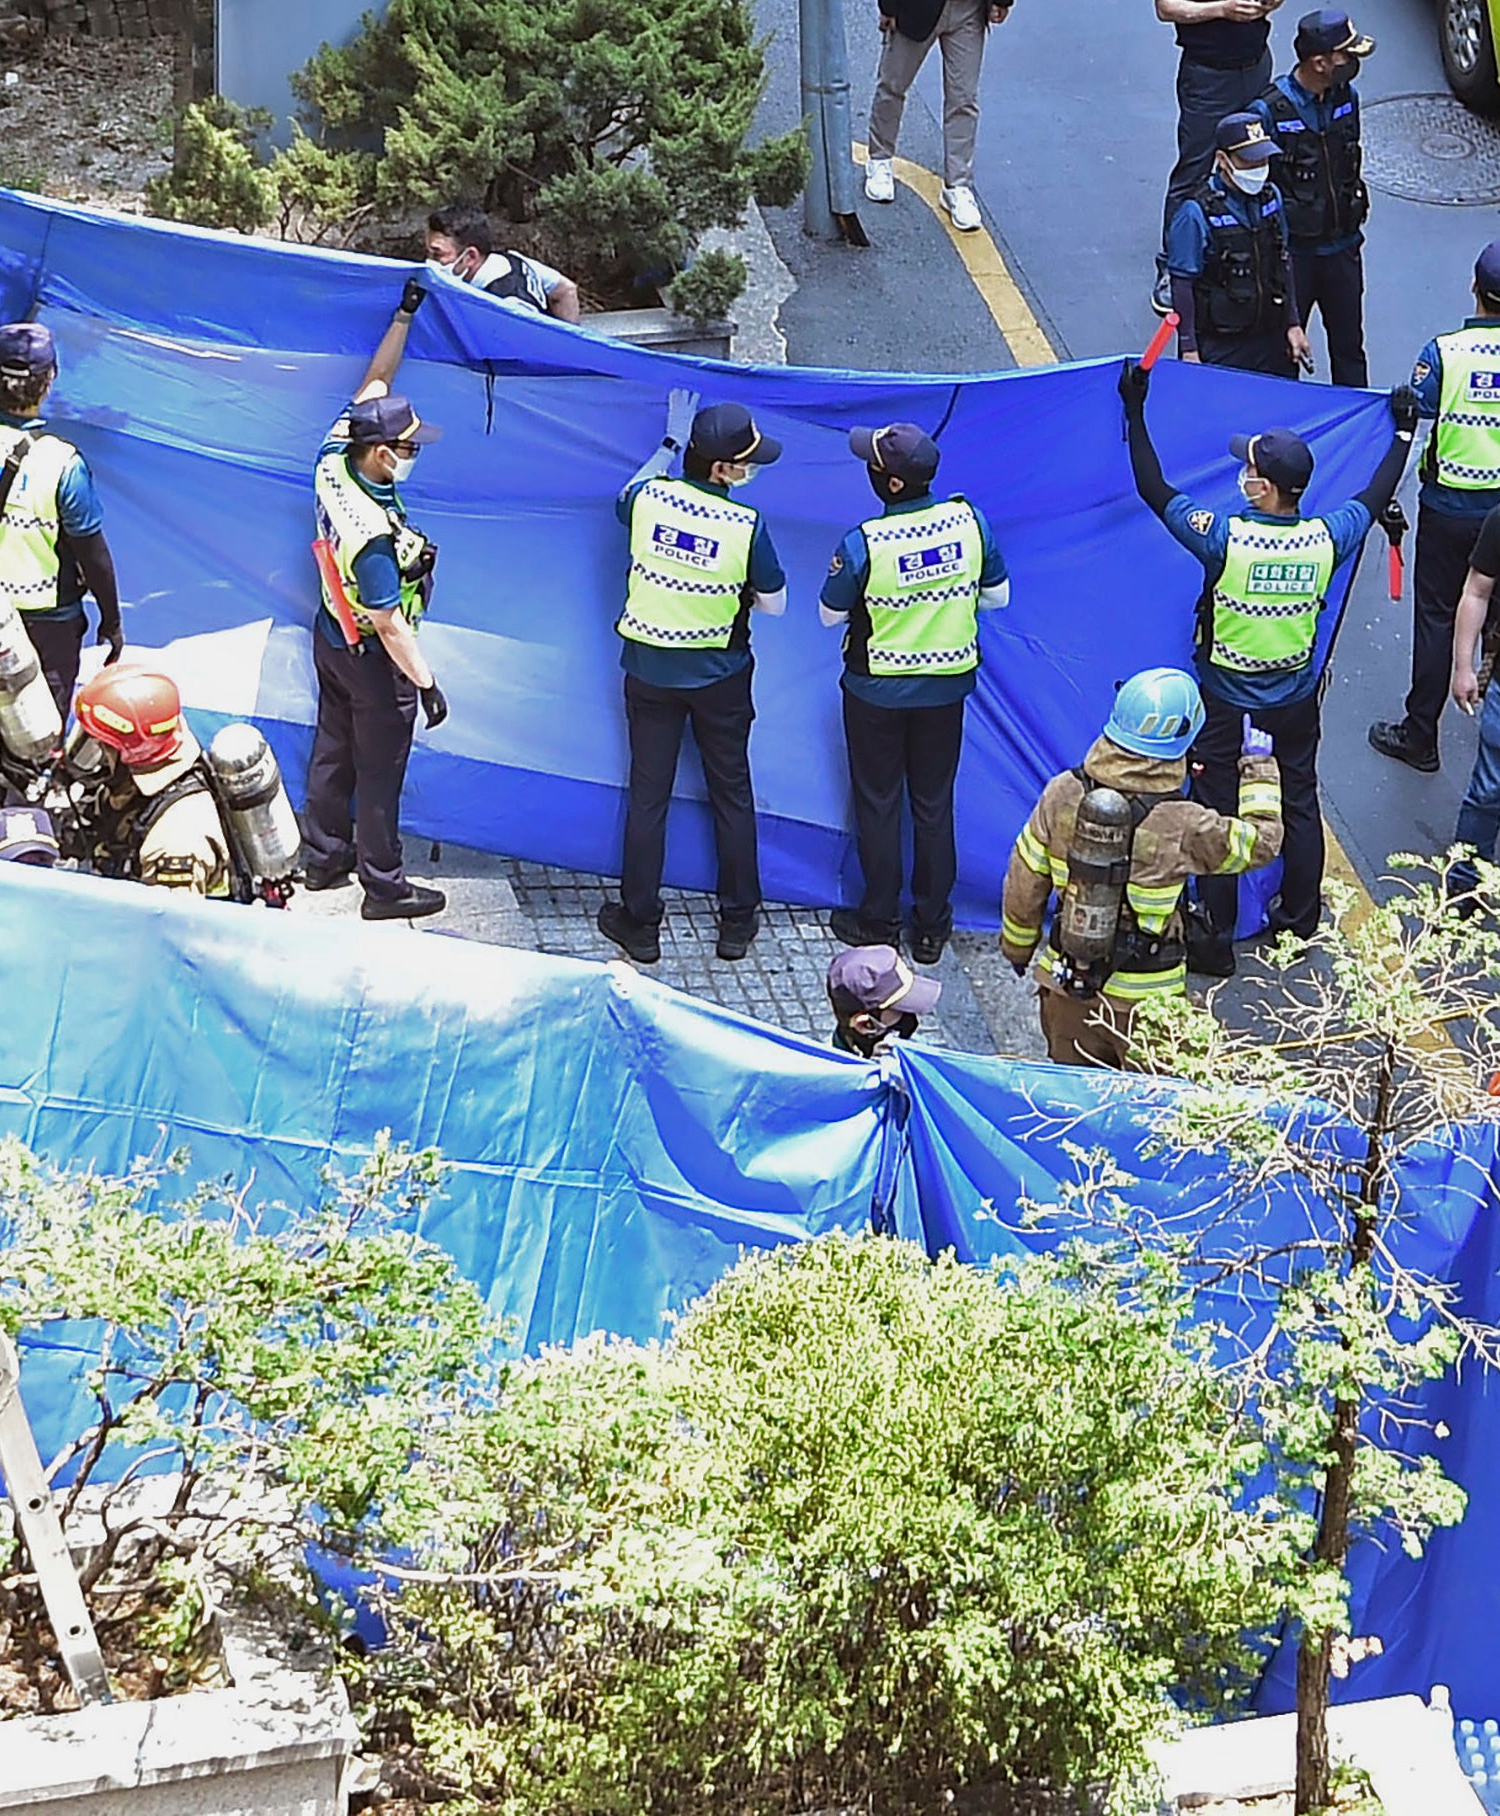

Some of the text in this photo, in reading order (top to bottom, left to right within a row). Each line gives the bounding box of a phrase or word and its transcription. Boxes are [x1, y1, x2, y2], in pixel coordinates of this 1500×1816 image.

[654, 544, 710, 567] POLICE
[904, 562, 960, 582] POLICE
[1253, 582, 1308, 591] POLICE
